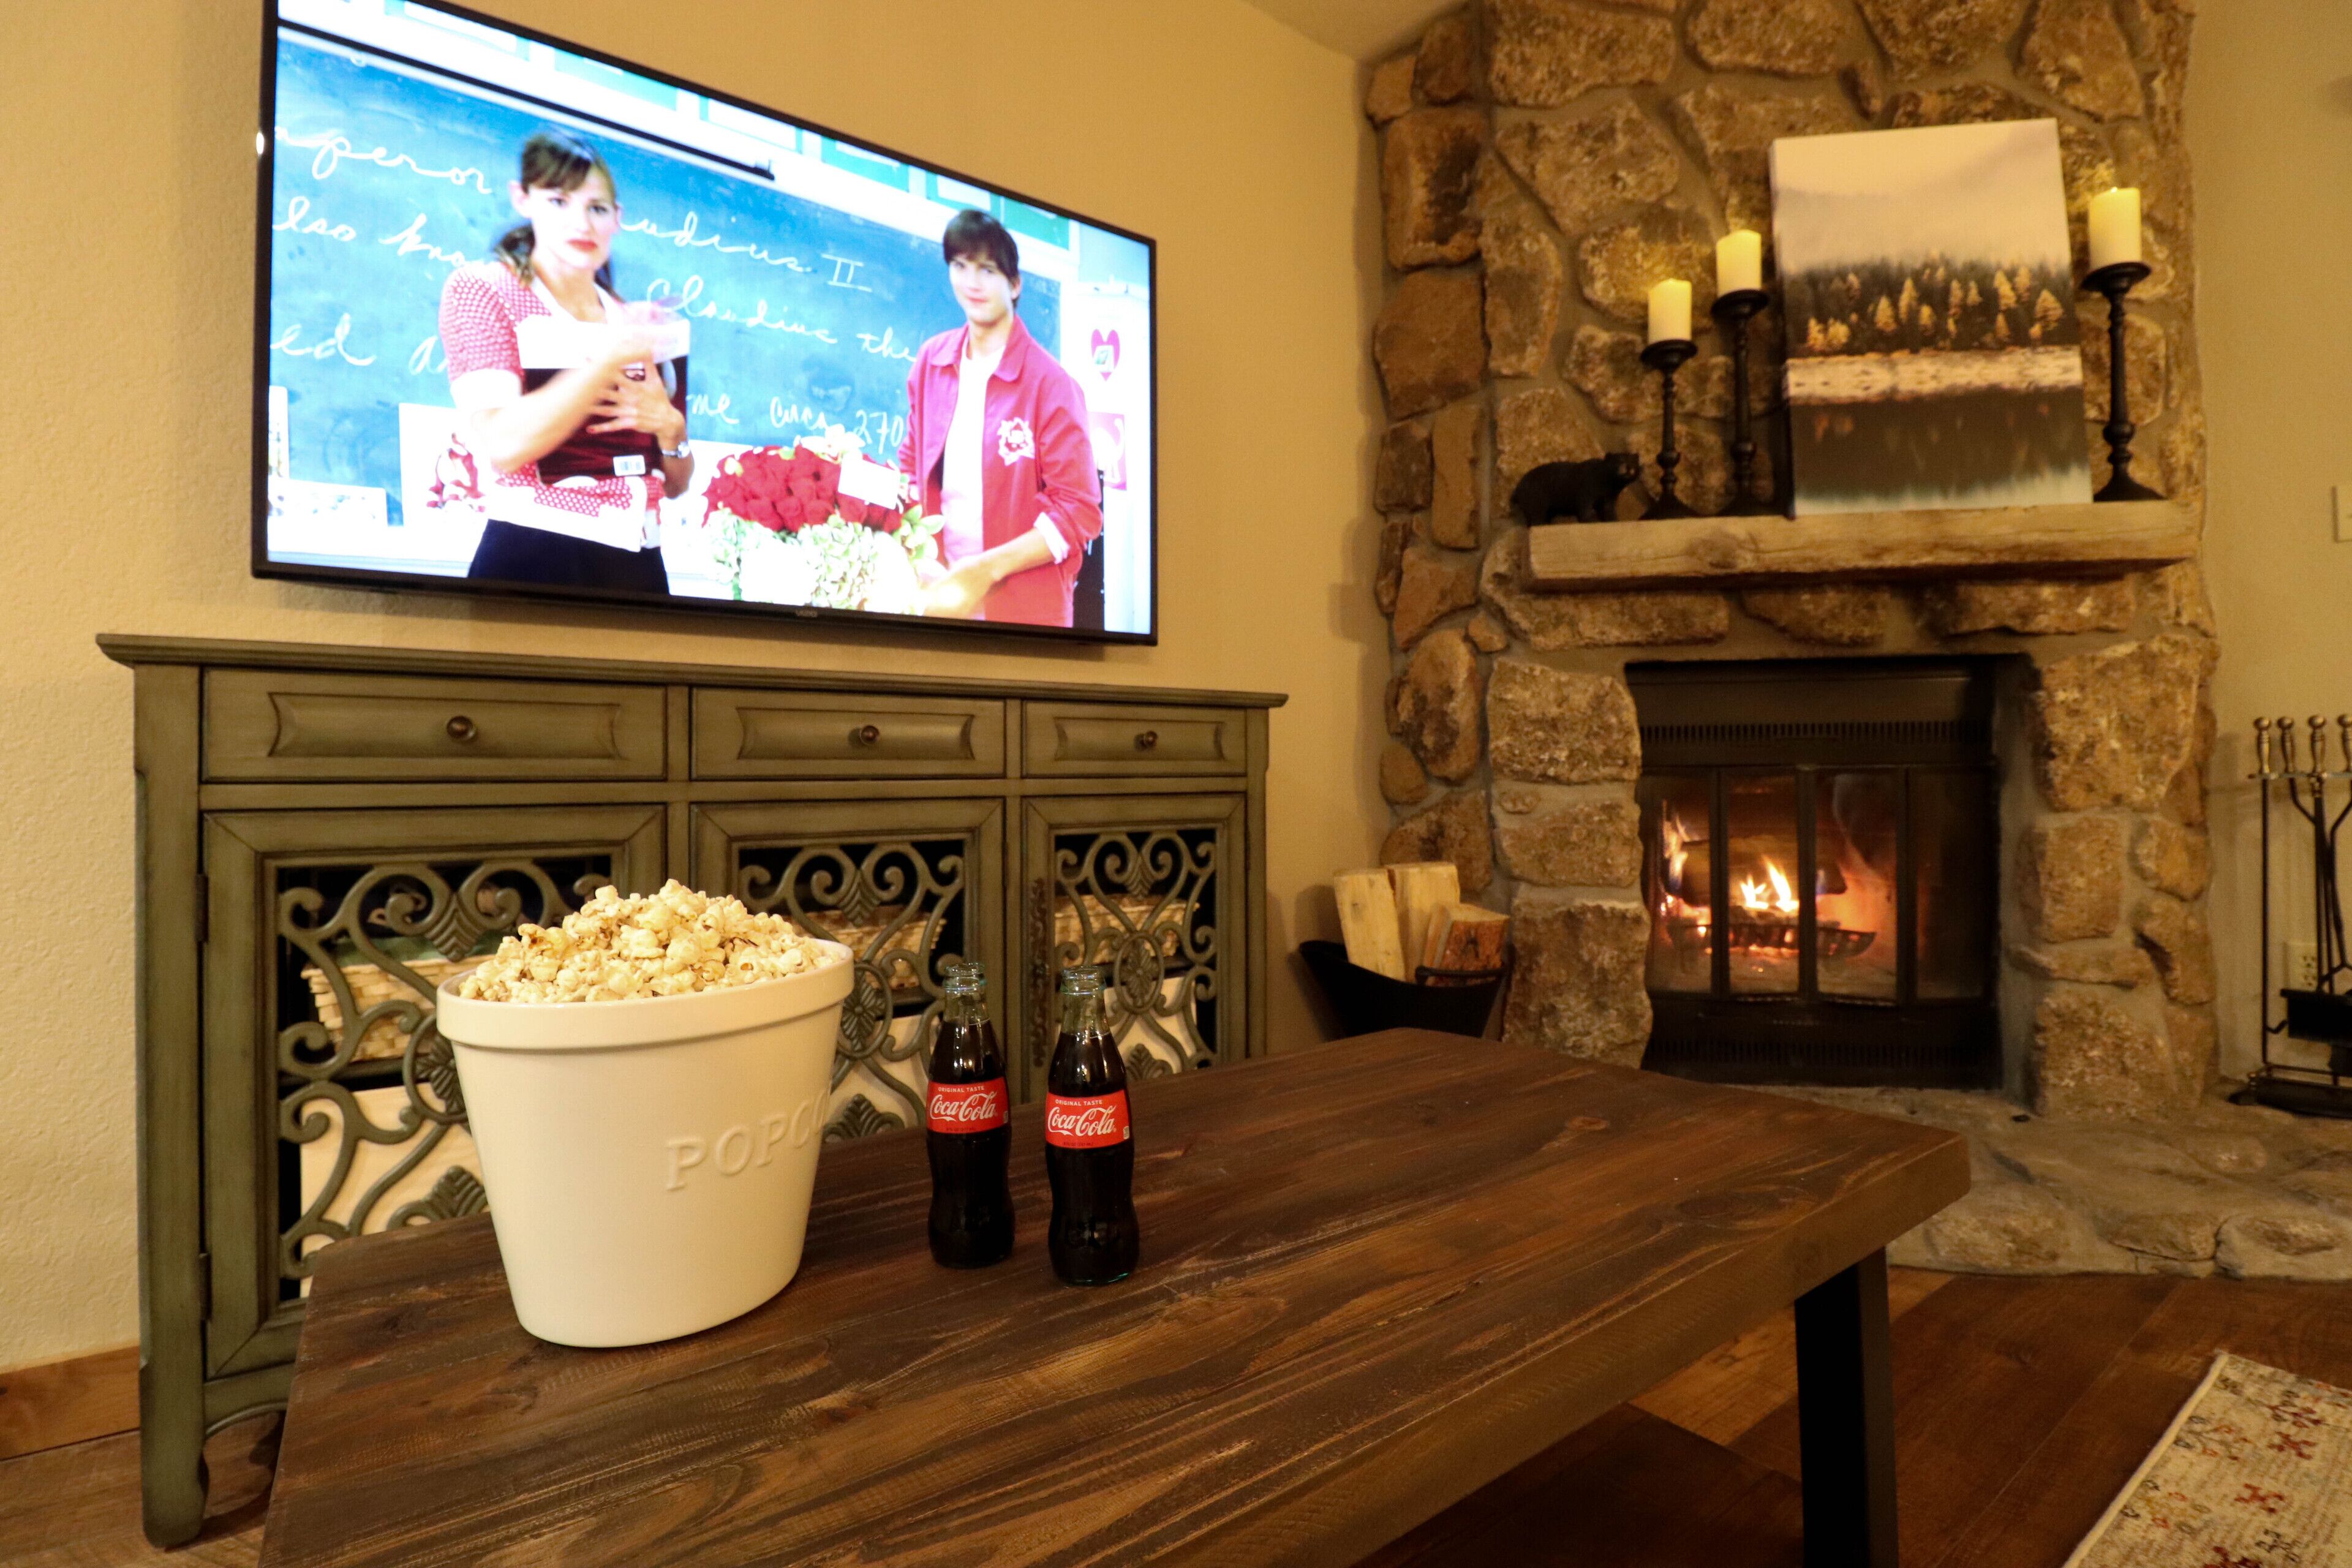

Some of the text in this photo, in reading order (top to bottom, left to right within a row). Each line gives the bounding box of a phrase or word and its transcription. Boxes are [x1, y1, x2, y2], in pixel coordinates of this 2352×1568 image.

[620, 210, 812, 273] udius
[821, 252, 873, 293] II
[856, 326, 918, 363] the
[855, 409, 904, 455] 270
[929, 1091, 998, 1122] Coca-Cola
[1047, 1104, 1117, 1137] Coca-Cola
